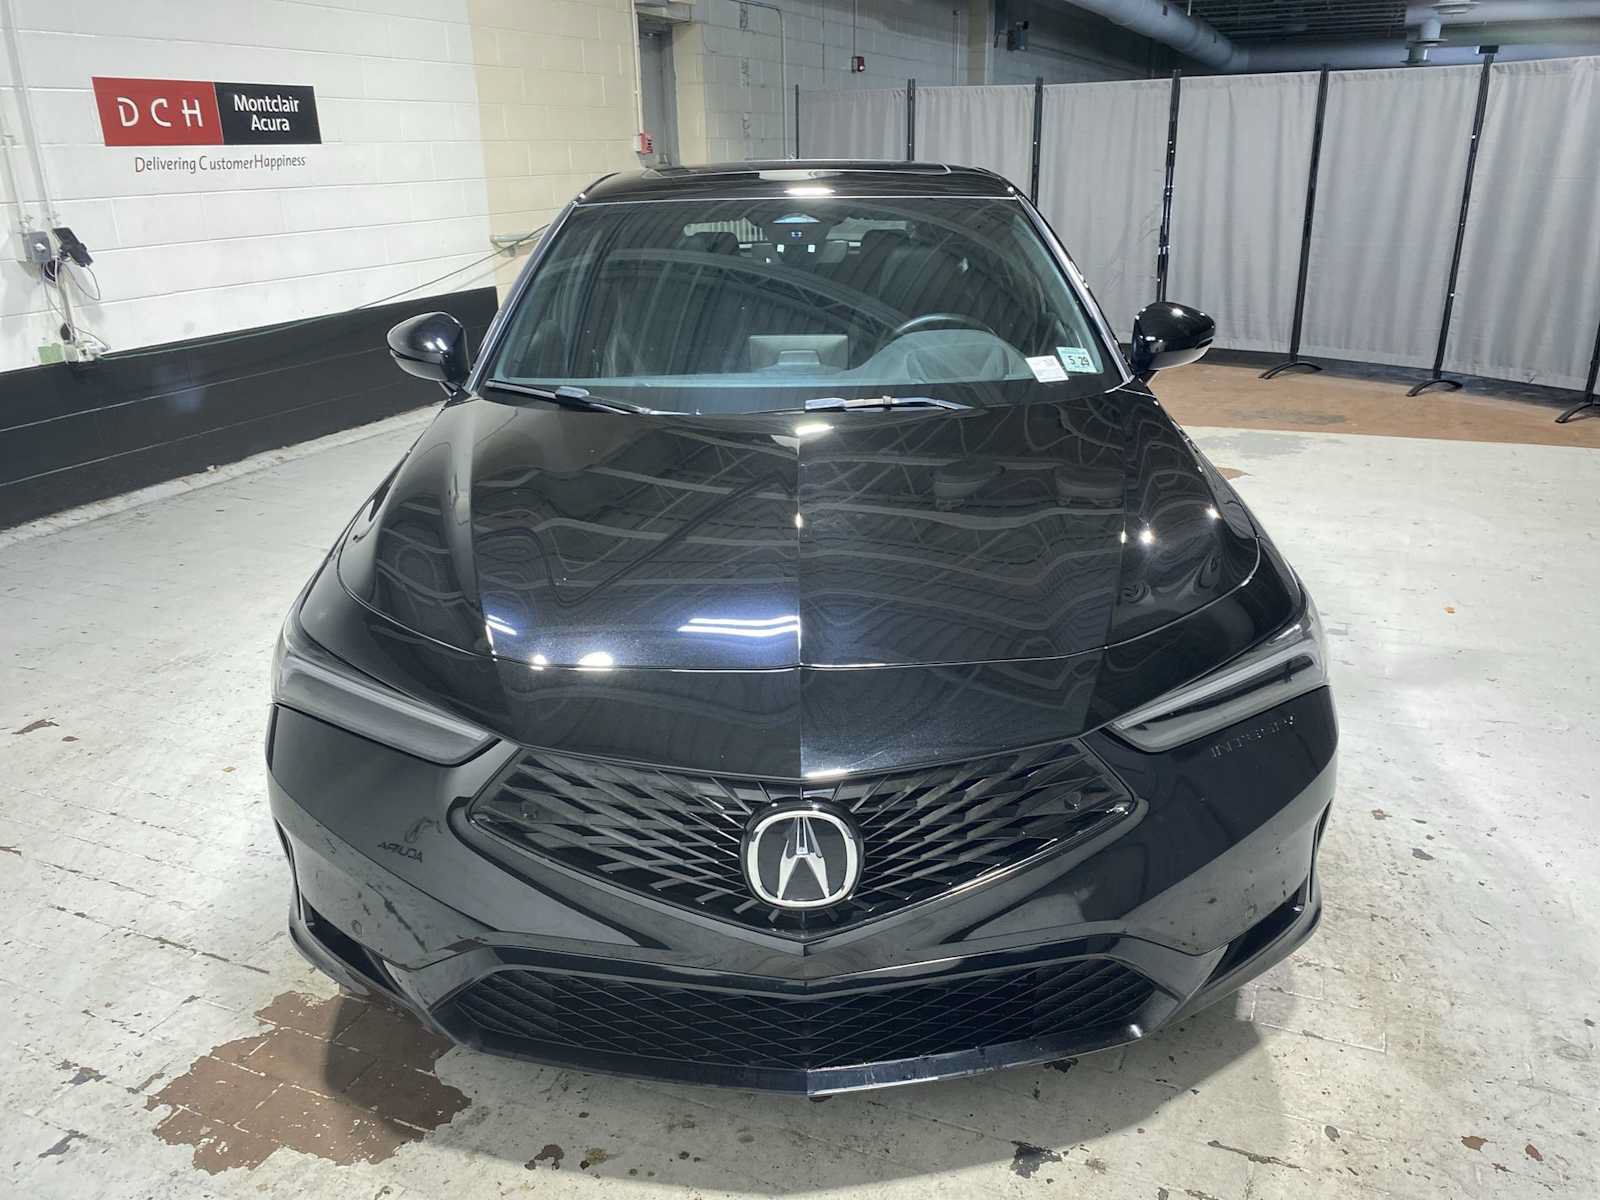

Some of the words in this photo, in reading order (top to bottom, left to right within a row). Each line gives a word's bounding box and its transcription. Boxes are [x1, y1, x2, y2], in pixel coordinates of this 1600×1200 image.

[116, 97, 204, 128] DCH
[234, 94, 299, 113] Montclair
[251, 115, 290, 131] Acura
[135, 157, 196, 174] Delivering
